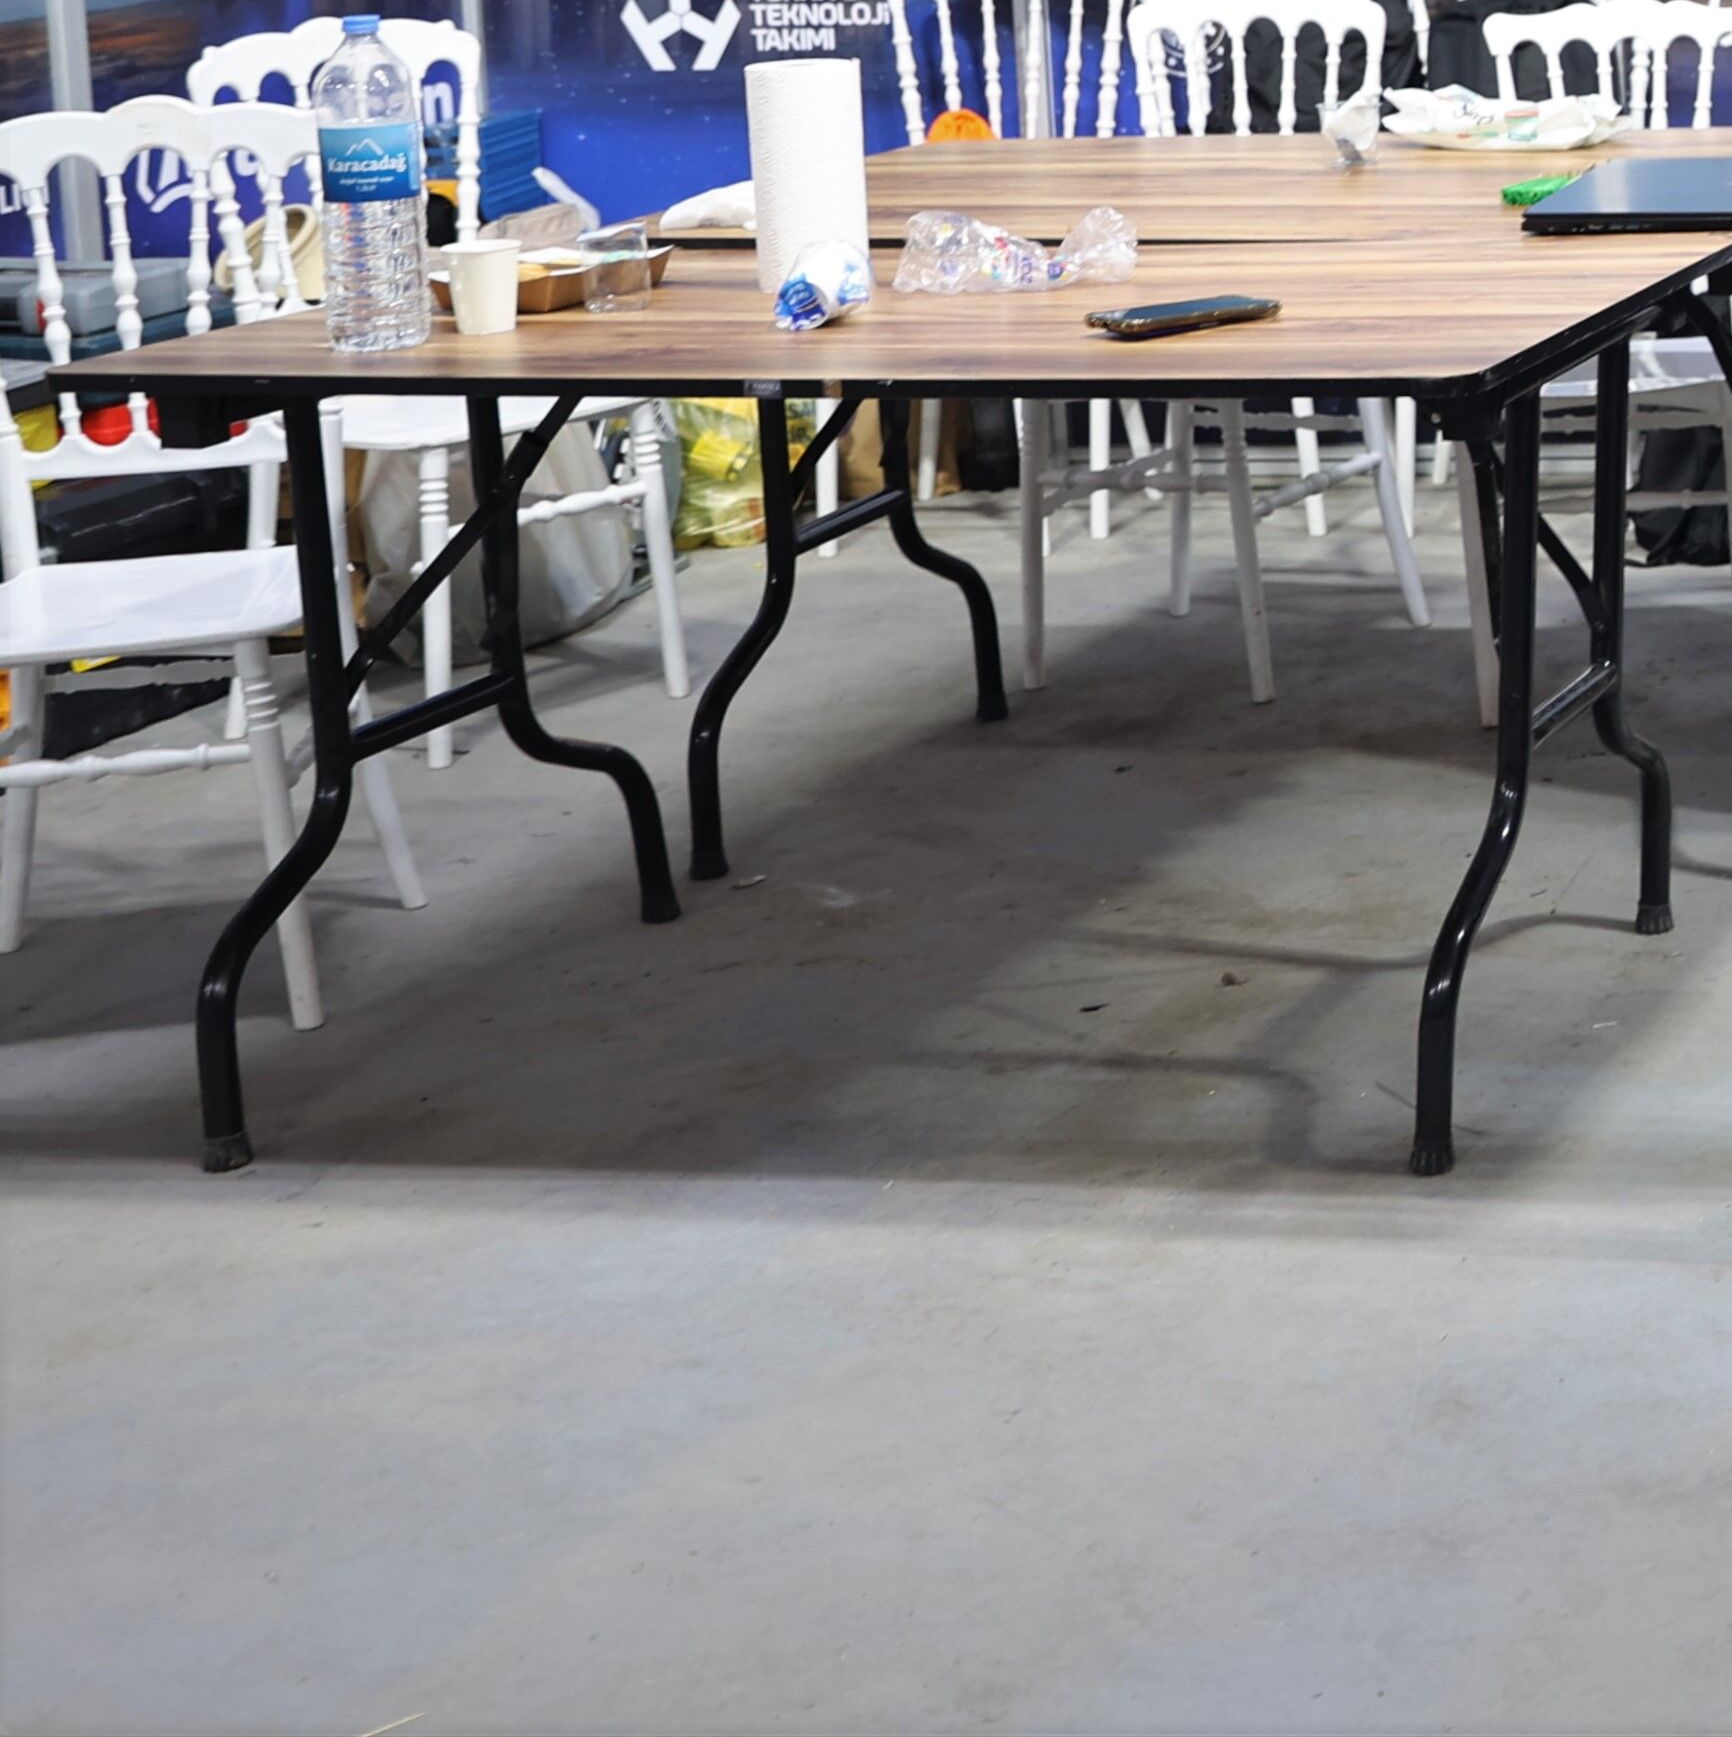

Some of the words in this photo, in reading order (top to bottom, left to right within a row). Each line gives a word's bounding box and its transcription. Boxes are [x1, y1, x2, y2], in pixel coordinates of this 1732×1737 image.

[749, 2, 891, 27] TEKNOLOJİ
[750, 28, 836, 52] TAKIMI
[327, 152, 407, 173] Karacadağ
